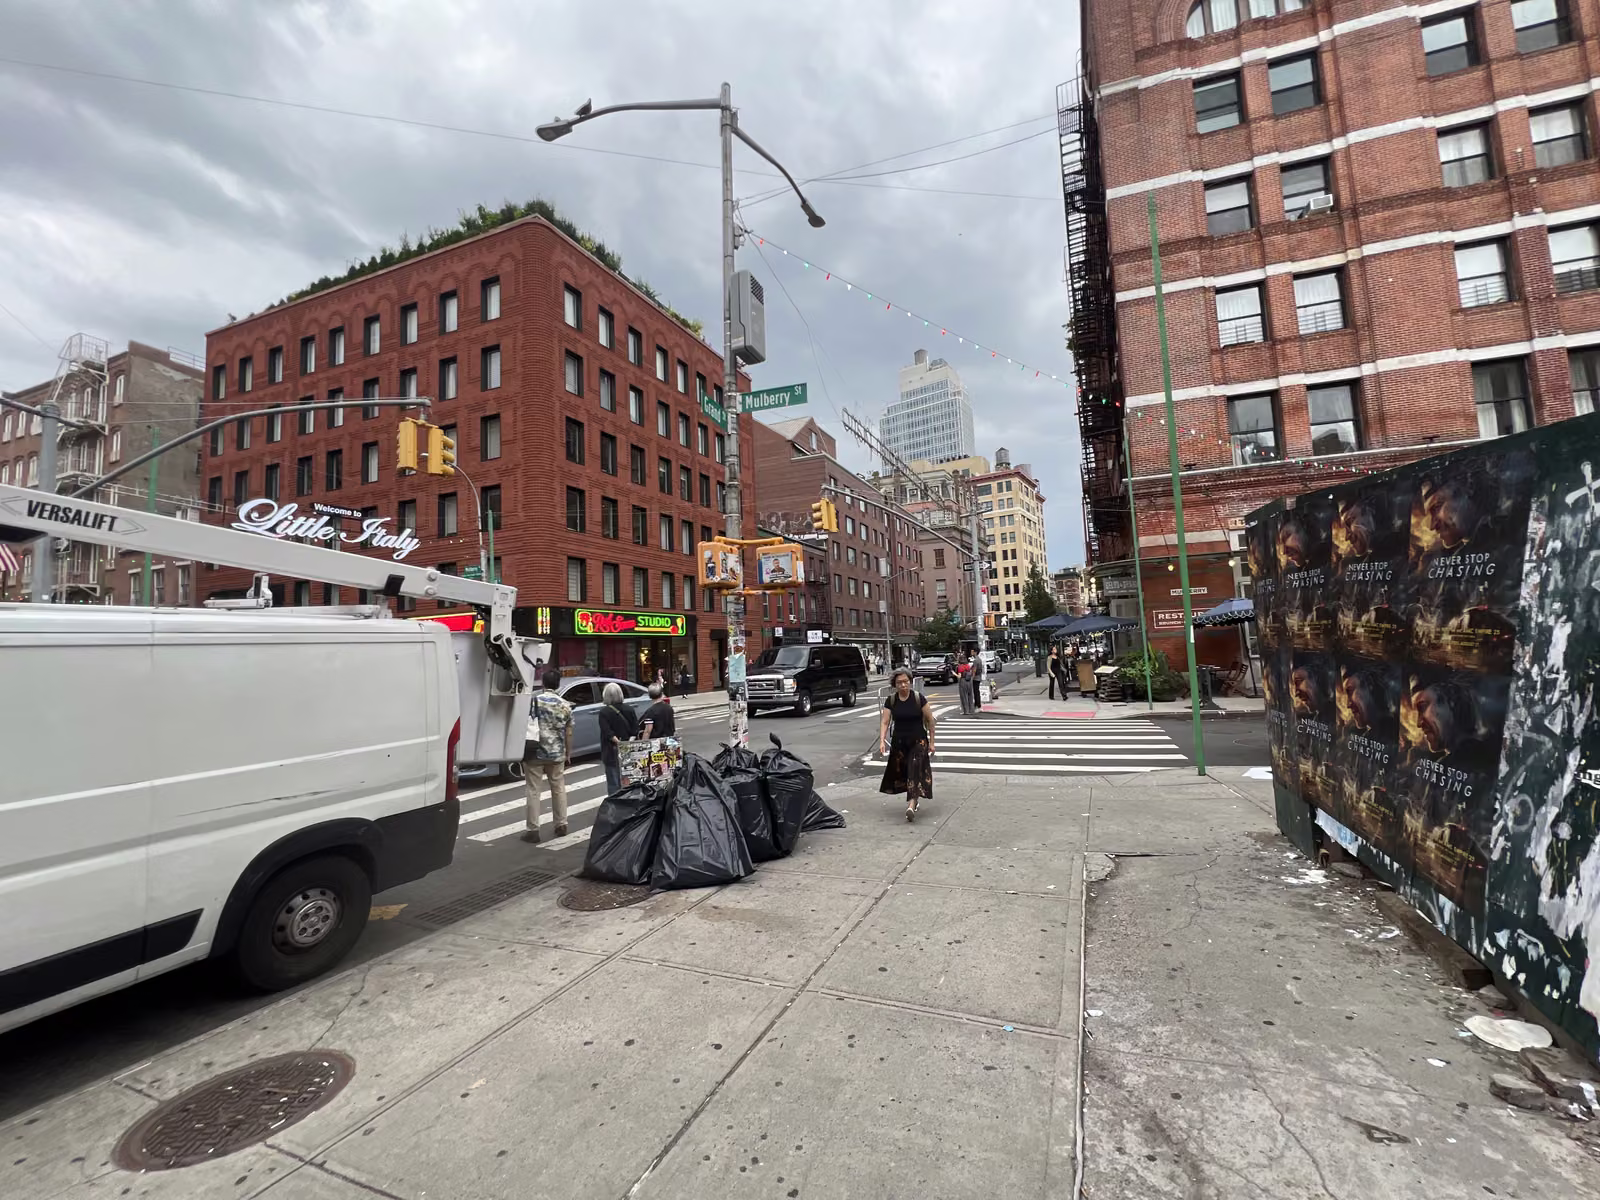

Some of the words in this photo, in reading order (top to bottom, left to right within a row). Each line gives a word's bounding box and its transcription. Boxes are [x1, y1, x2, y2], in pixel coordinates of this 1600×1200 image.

[745, 392, 790, 409] Mulberry
[794, 385, 802, 396] St
[704, 395, 721, 423] Grand
[27, 500, 118, 532] VERSALIFT
[314, 502, 352, 516] Welcome
[353, 510, 362, 518] to
[231, 499, 335, 538] Little
[340, 517, 421, 560] Italy
[1348, 563, 1369, 571] NEVER
[1370, 561, 1388, 571] STOP
[1433, 555, 1461, 566] NEVER
[1465, 552, 1490, 564] STOP
[1287, 571, 1308, 580] NEVER
[1345, 570, 1393, 581] CHASING
[1428, 563, 1496, 579] CHASING
[637, 616, 671, 627] STUDIO
[1296, 725, 1331, 742] CHASING
[1350, 733, 1368, 746] NEVER
[1370, 740, 1385, 751] STOP
[1347, 740, 1389, 764] CHASING
[1420, 758, 1444, 774] NEVER
[1447, 767, 1468, 781] STOP
[1415, 766, 1473, 797] CHASING
